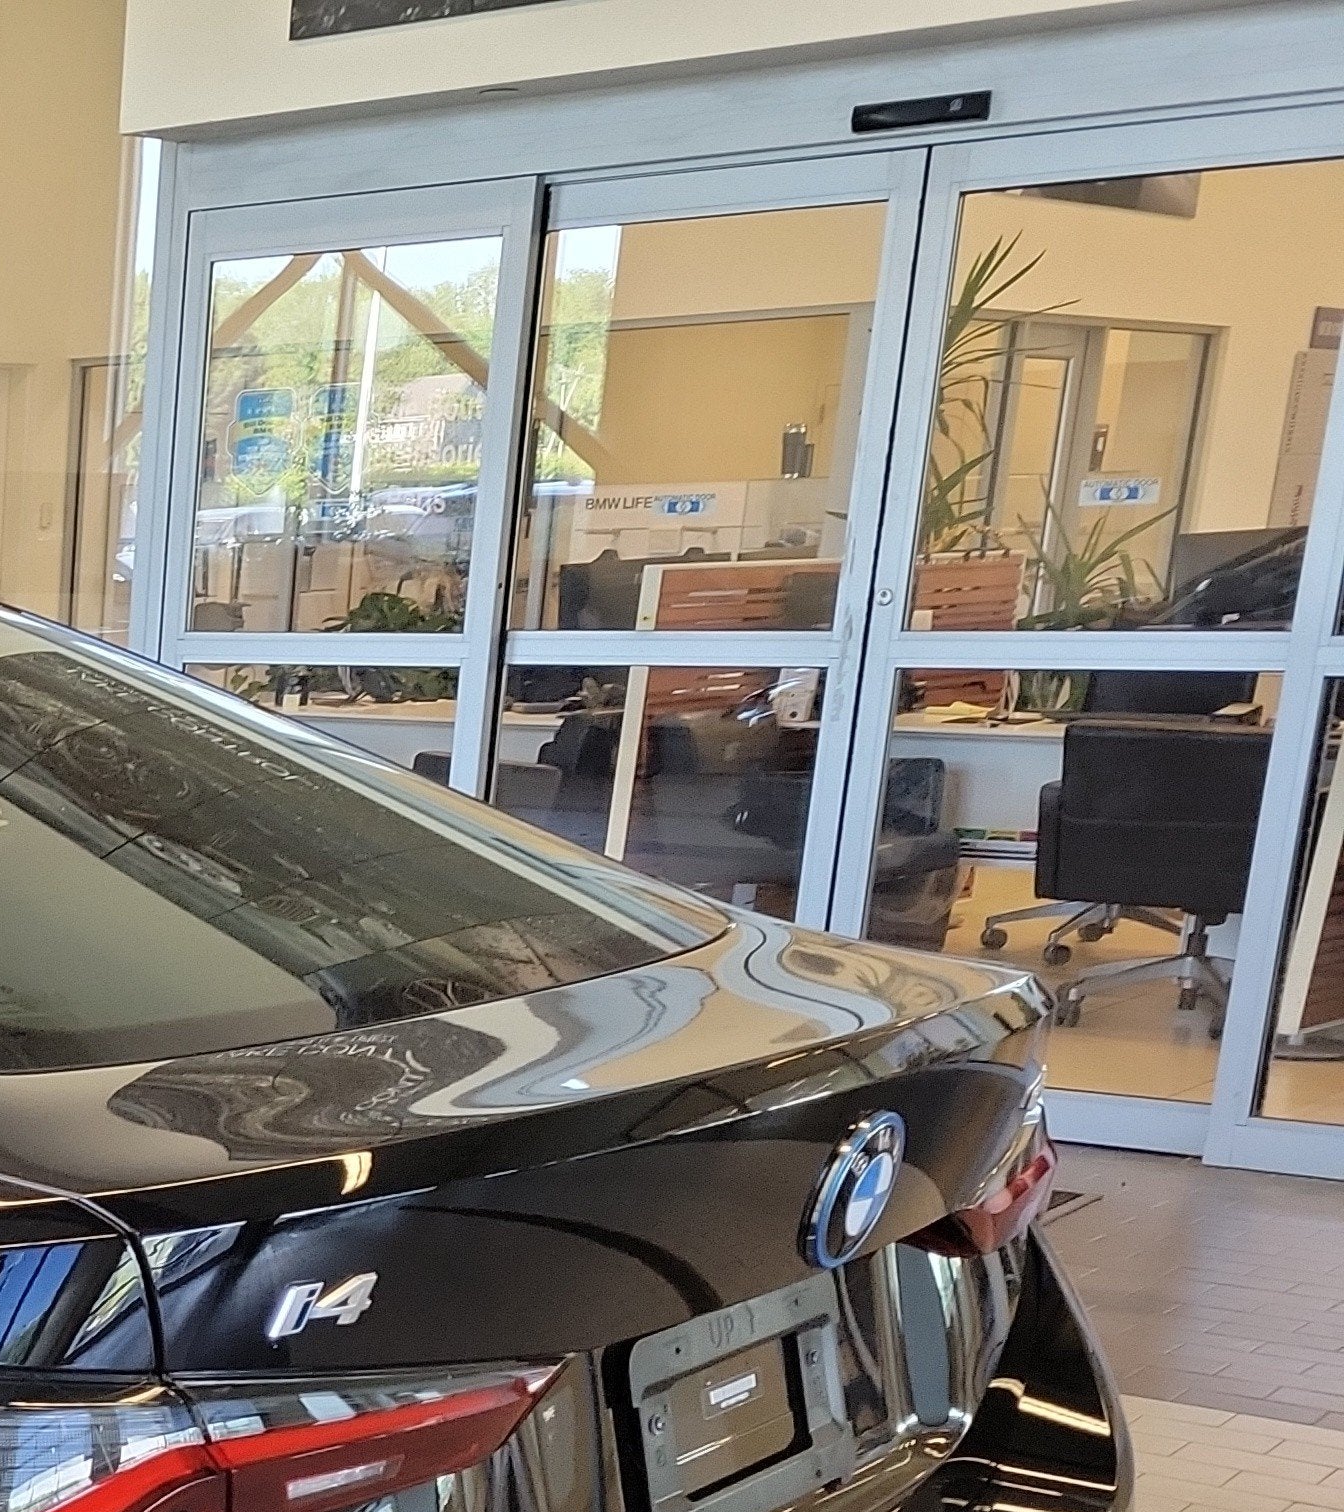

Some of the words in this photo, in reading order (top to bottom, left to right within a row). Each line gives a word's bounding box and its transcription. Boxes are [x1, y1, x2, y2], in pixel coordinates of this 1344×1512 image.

[585, 497, 621, 510] BMW
[622, 496, 653, 509] LIFE
[268, 1271, 379, 1338] i4
